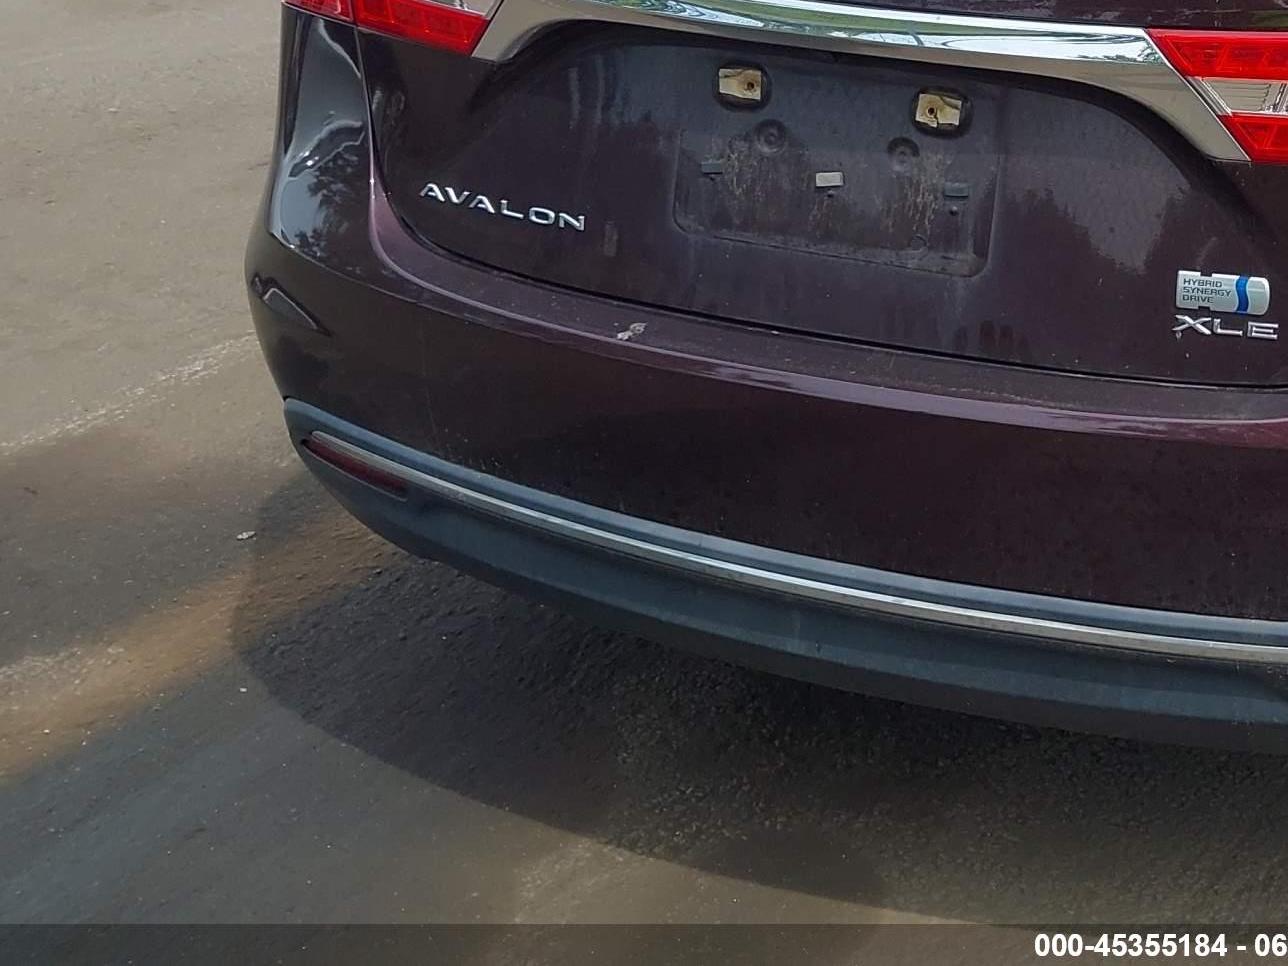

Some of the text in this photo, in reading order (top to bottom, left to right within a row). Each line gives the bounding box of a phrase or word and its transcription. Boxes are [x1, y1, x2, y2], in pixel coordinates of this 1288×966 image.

[419, 183, 586, 231] AVALON
[1183, 278, 1223, 288] HYBRID
[1183, 287, 1232, 297] SYNERGY
[1182, 294, 1215, 303] DRIVE
[1172, 314, 1279, 339] XLE
